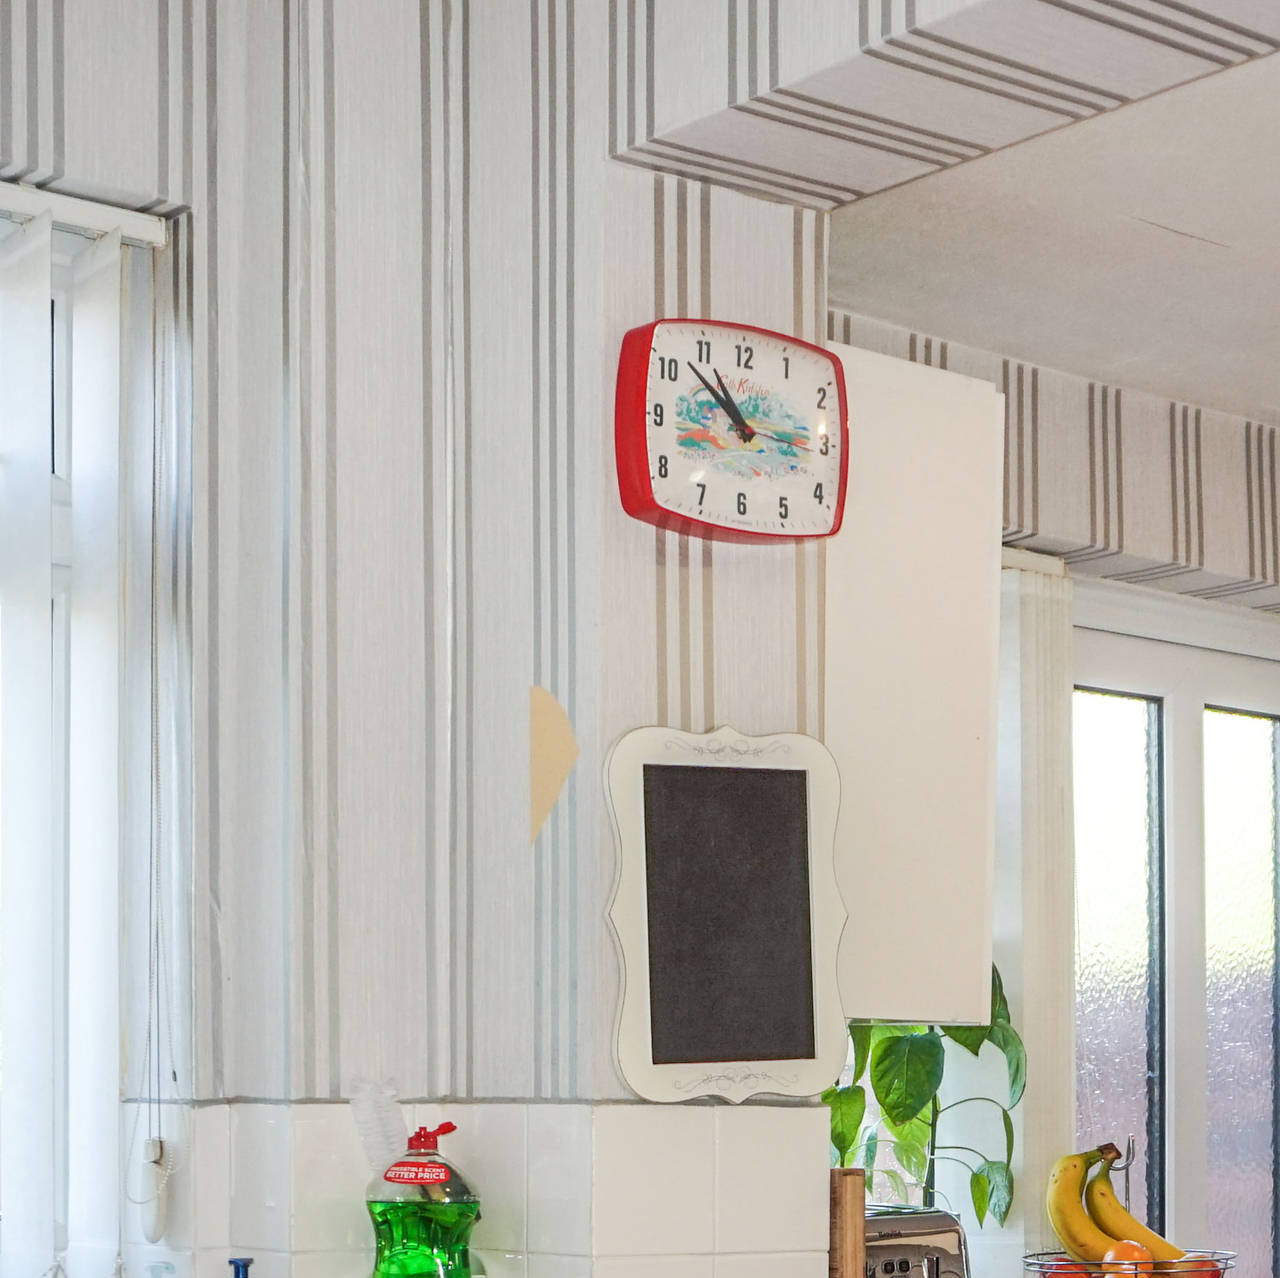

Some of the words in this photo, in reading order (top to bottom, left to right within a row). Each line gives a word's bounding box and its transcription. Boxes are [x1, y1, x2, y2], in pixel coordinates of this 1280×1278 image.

[696, 340, 711, 364] 11
[735, 345, 753, 369] 12
[658, 357, 678, 381] 10
[783, 357, 789, 379] 1
[817, 387, 827, 409] 2
[653, 403, 664, 426] 9
[819, 435, 829, 456] 3
[658, 455, 668, 478] 8
[696, 484, 706, 506] 7
[737, 493, 747, 515] 6
[813, 483, 824, 504] 4
[779, 497, 788, 519] 5
[387, 1171, 416, 1179] BETTER
